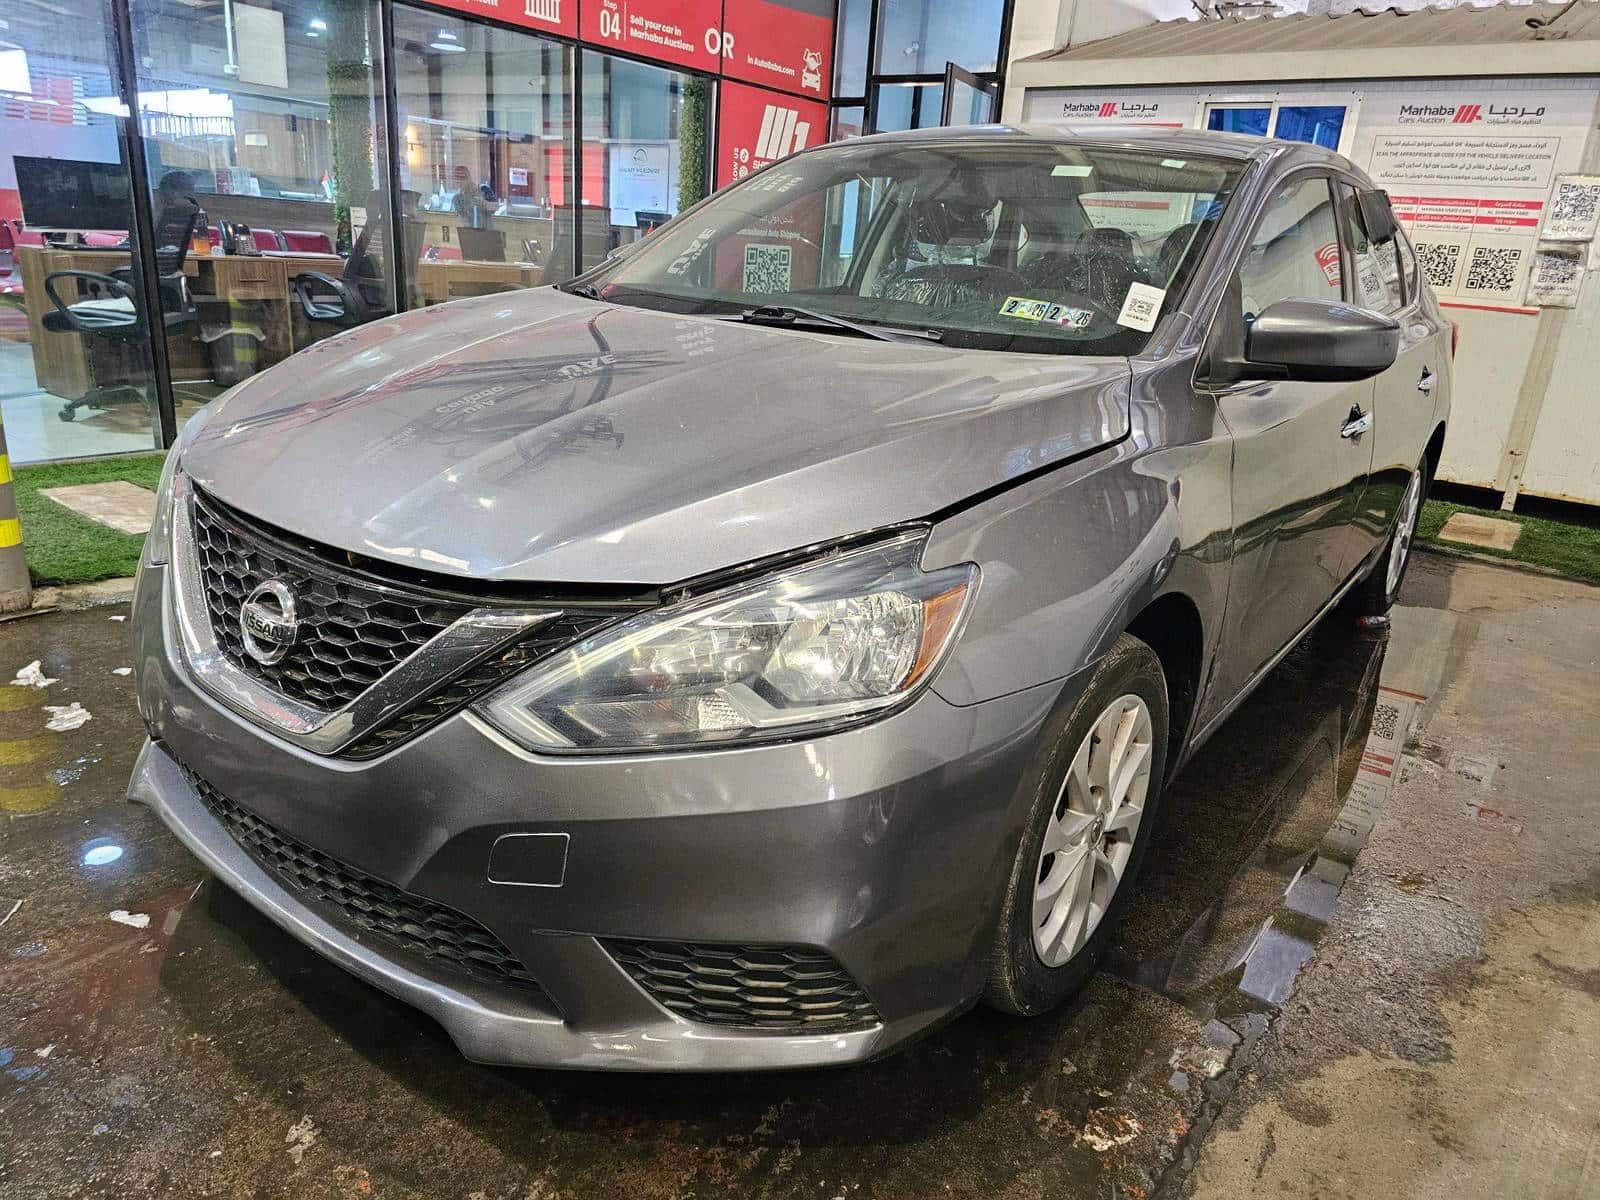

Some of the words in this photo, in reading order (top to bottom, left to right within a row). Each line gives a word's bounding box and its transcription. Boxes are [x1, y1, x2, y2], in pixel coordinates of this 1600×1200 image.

[600, 9, 621, 40] 04
[630, 14, 644, 25] Sell
[644, 18, 662, 30] your
[662, 24, 674, 34] car
[674, 25, 682, 36] in
[630, 27, 663, 45] Marhaba
[664, 36, 695, 52] Auctions
[704, 28, 735, 59] OR
[1063, 103, 1100, 112] Marhaba
[1399, 104, 1455, 116] Marhaba
[1398, 116, 1415, 124] Cars
[1417, 116, 1446, 124] Auction
[1006, 300, 1018, 314] 2
[1031, 303, 1045, 318] 26
[1050, 306, 1061, 321] 2
[1075, 311, 1091, 326] 26
